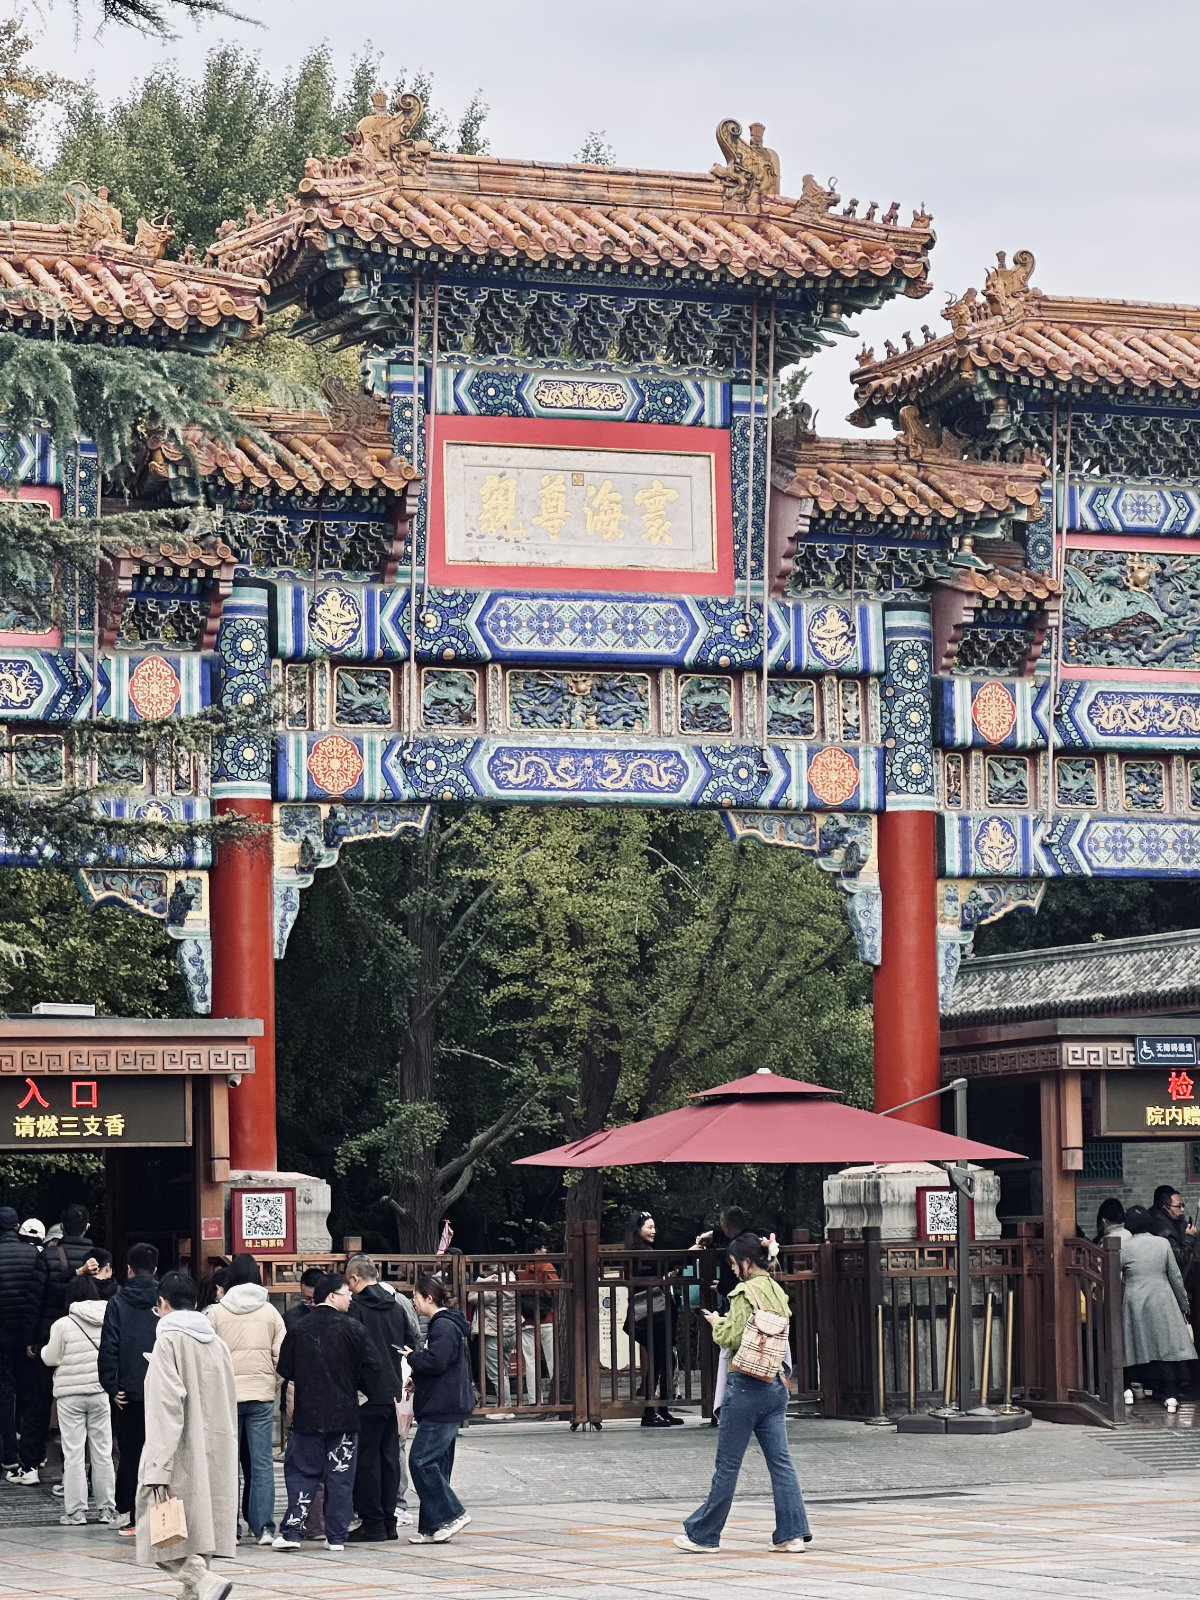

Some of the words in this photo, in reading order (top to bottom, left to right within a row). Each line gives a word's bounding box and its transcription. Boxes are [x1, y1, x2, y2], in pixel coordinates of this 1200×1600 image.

[1155, 1043, 1193, 1052] 无障碍通道
[17, 1077, 98, 1109] 入口
[1168, 1072, 1194, 1101] 检
[13, 1114, 125, 1137] 请燃三支香
[1145, 1105, 1200, 1126] 院内赠
[245, 1239, 284, 1248] 线上购票码
